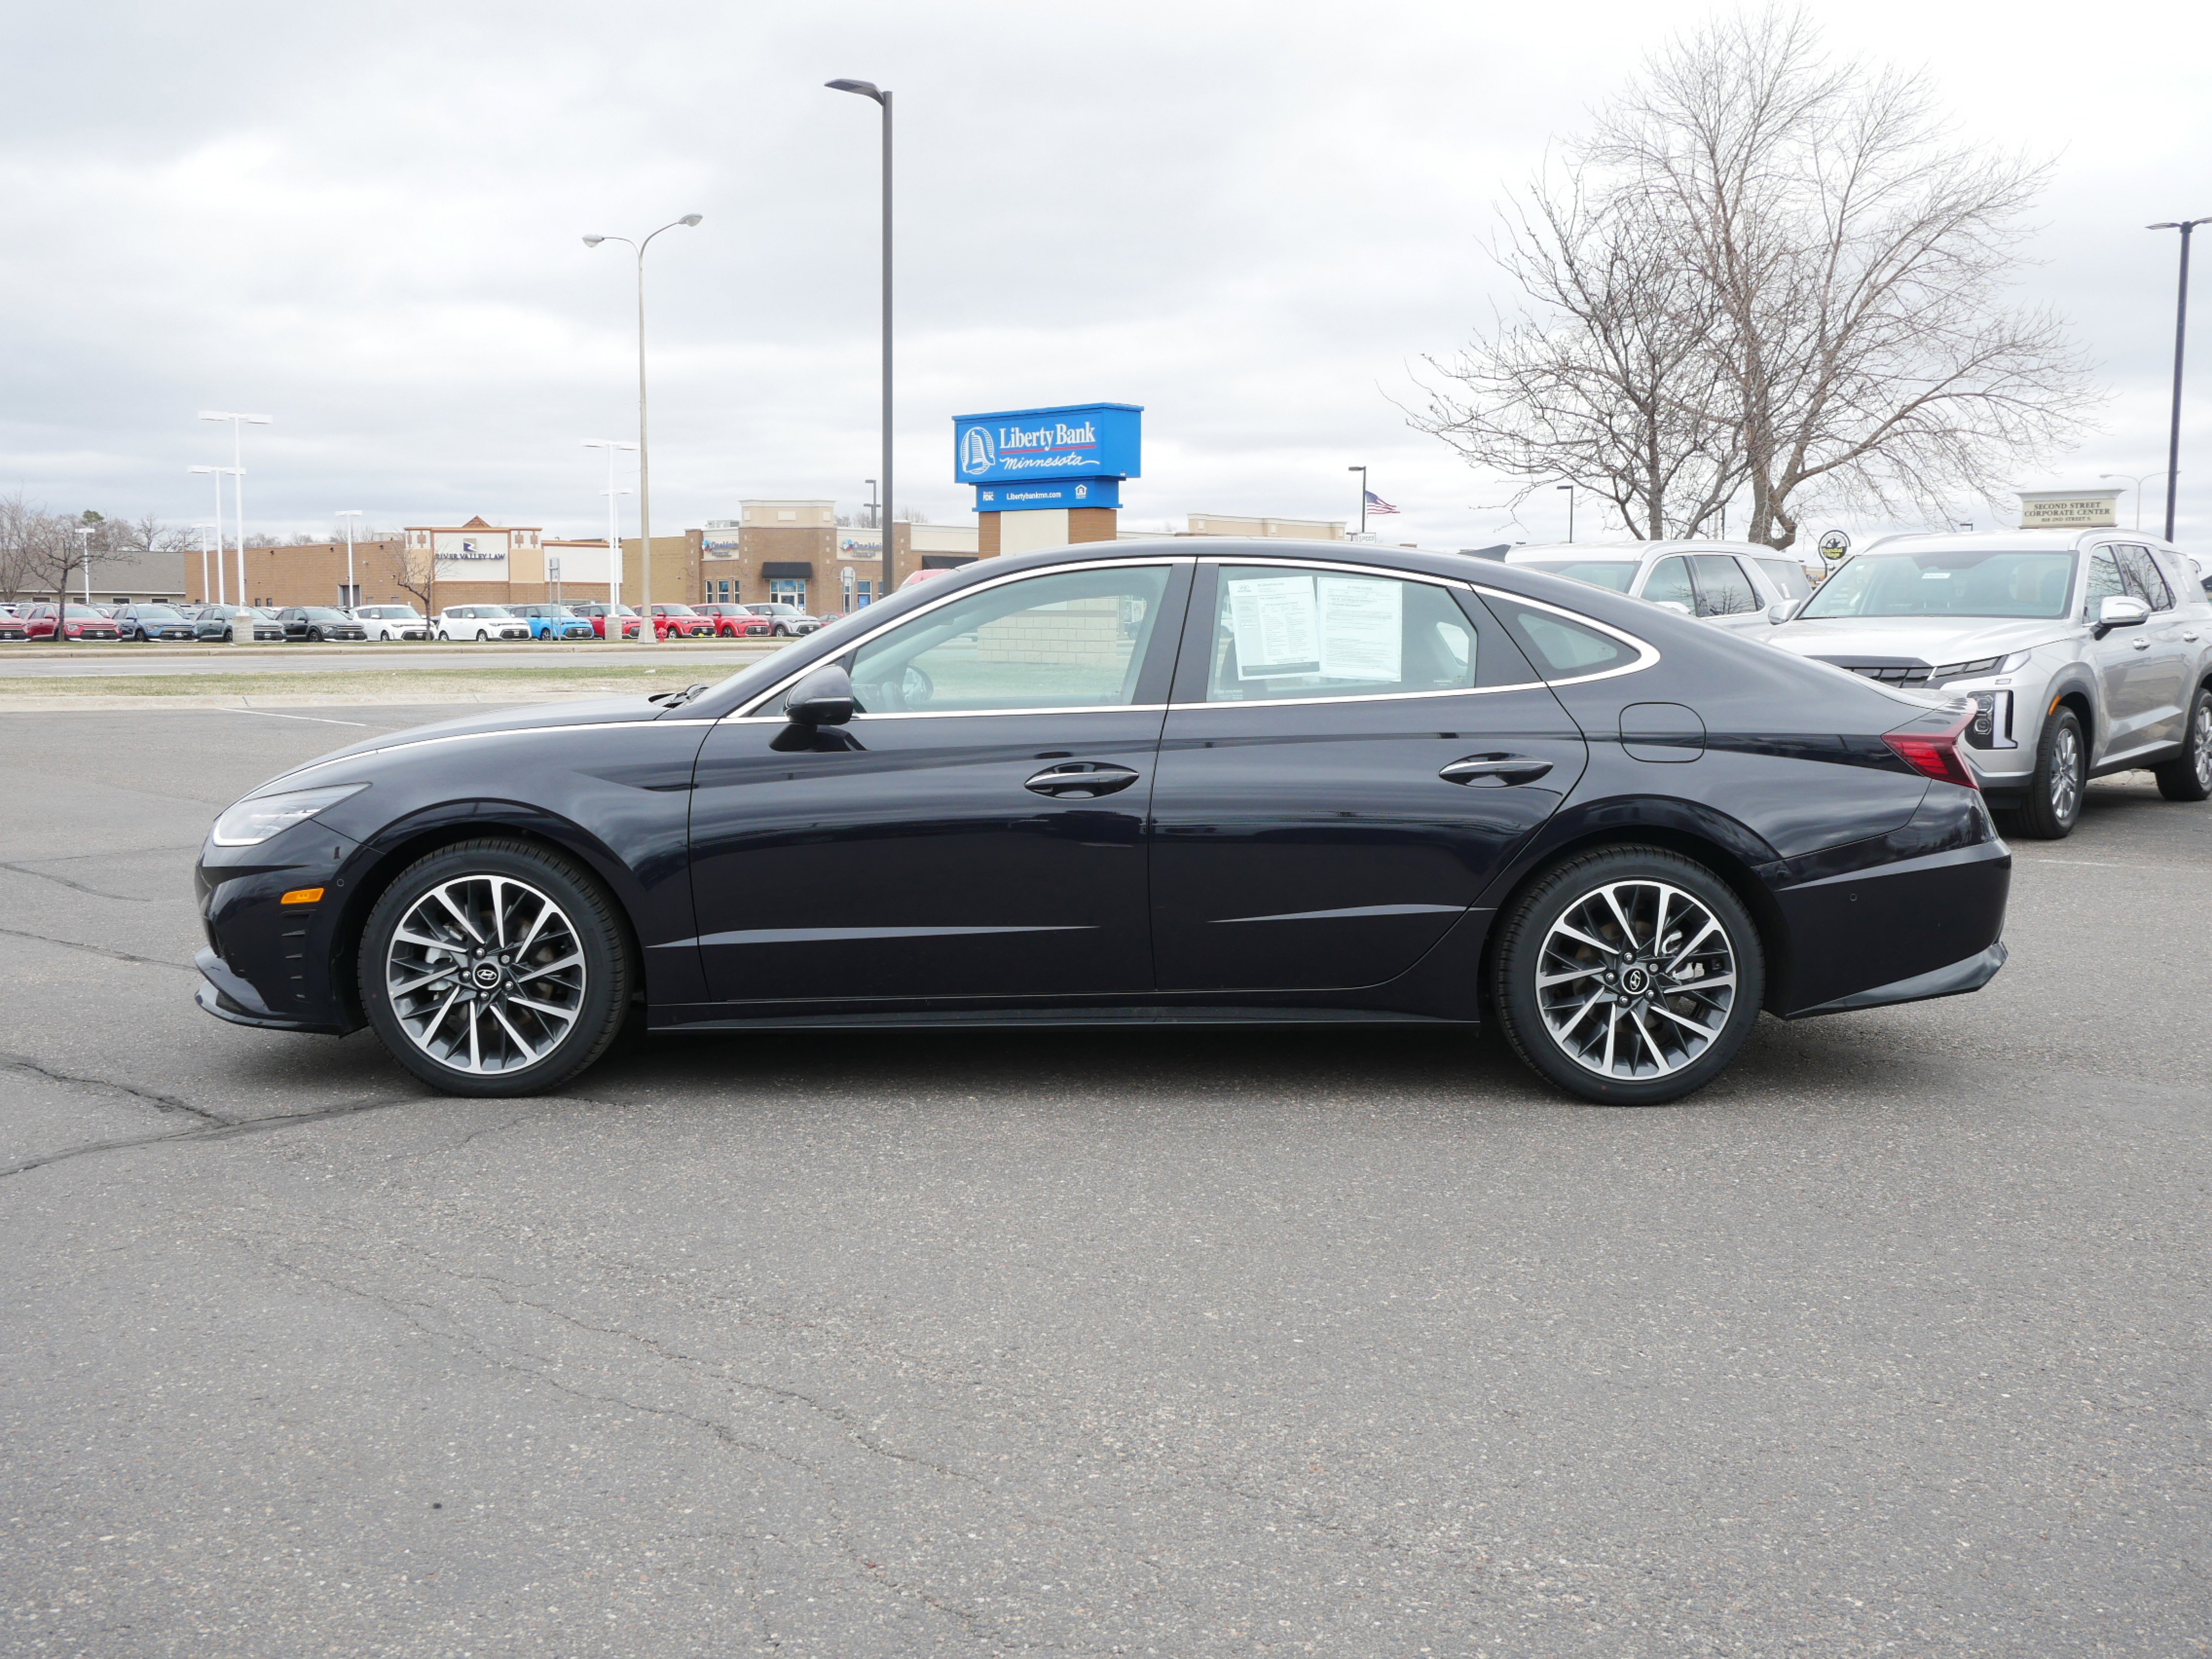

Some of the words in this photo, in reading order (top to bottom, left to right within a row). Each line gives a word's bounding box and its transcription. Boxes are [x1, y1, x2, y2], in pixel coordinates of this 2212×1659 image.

[999, 427, 1054, 451] Liberty
[1055, 421, 1096, 445] Bank
[1006, 492, 1061, 501] Libertybankmn.com
[853, 542, 882, 550] OneMai
